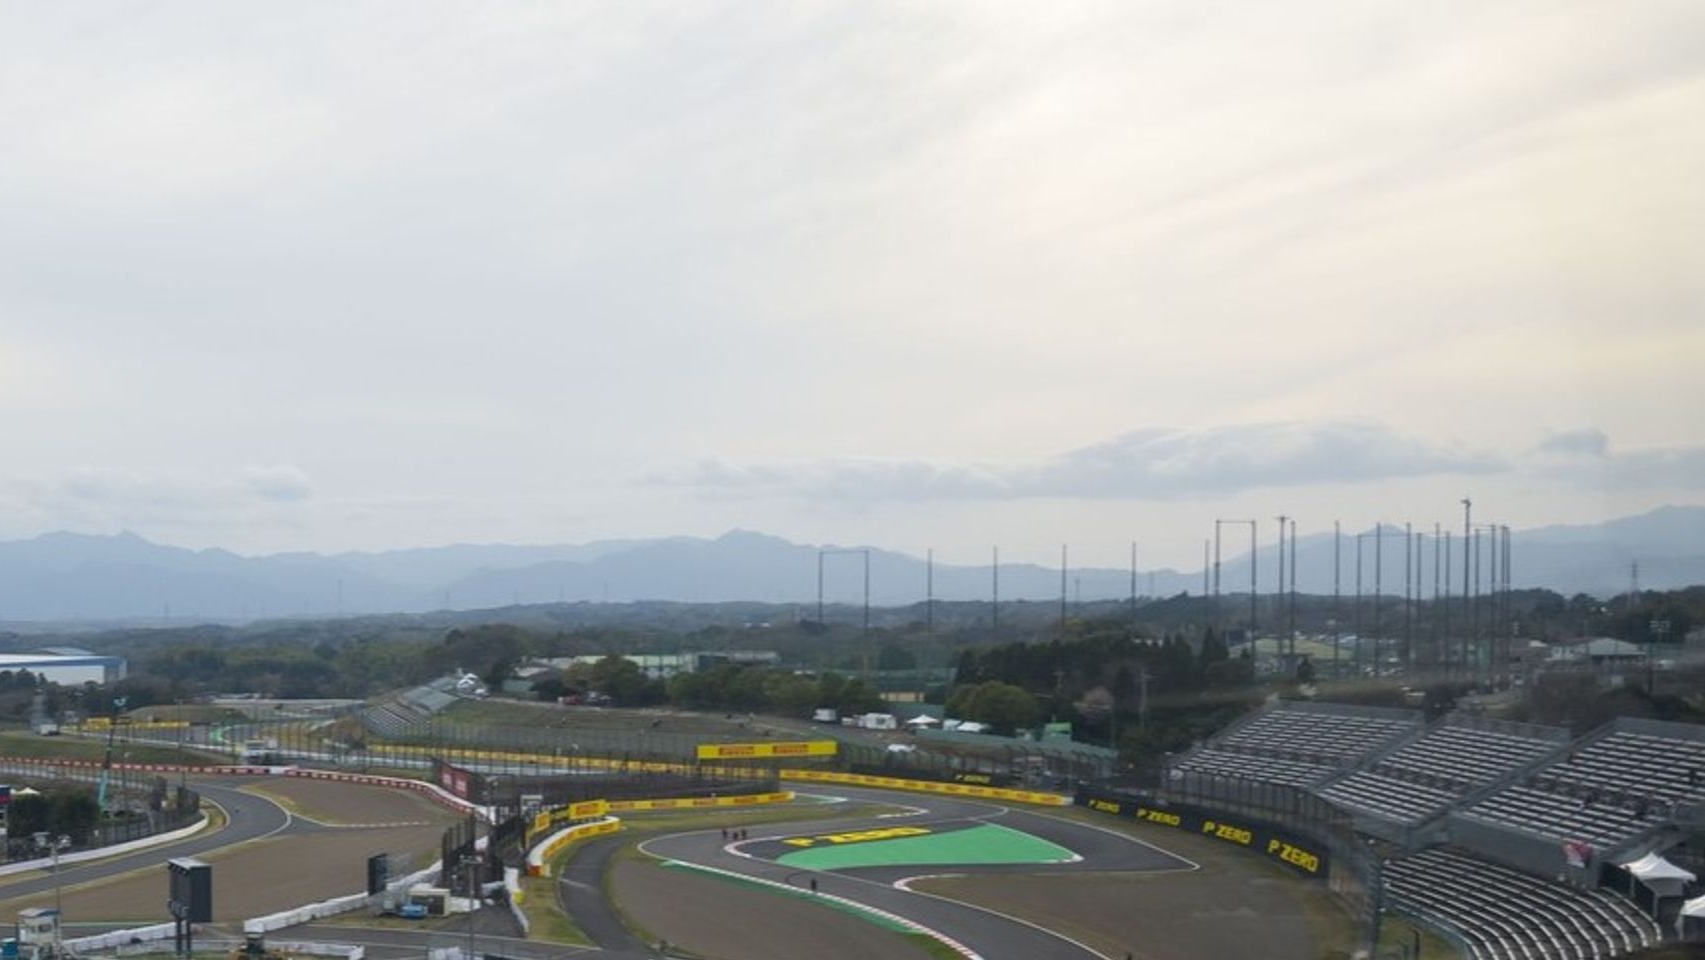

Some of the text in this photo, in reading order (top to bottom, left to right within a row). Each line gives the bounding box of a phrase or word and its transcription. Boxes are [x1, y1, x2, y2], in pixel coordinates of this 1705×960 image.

[1203, 822, 1251, 845] P ZERO
[1268, 839, 1319, 873] P ZERO
